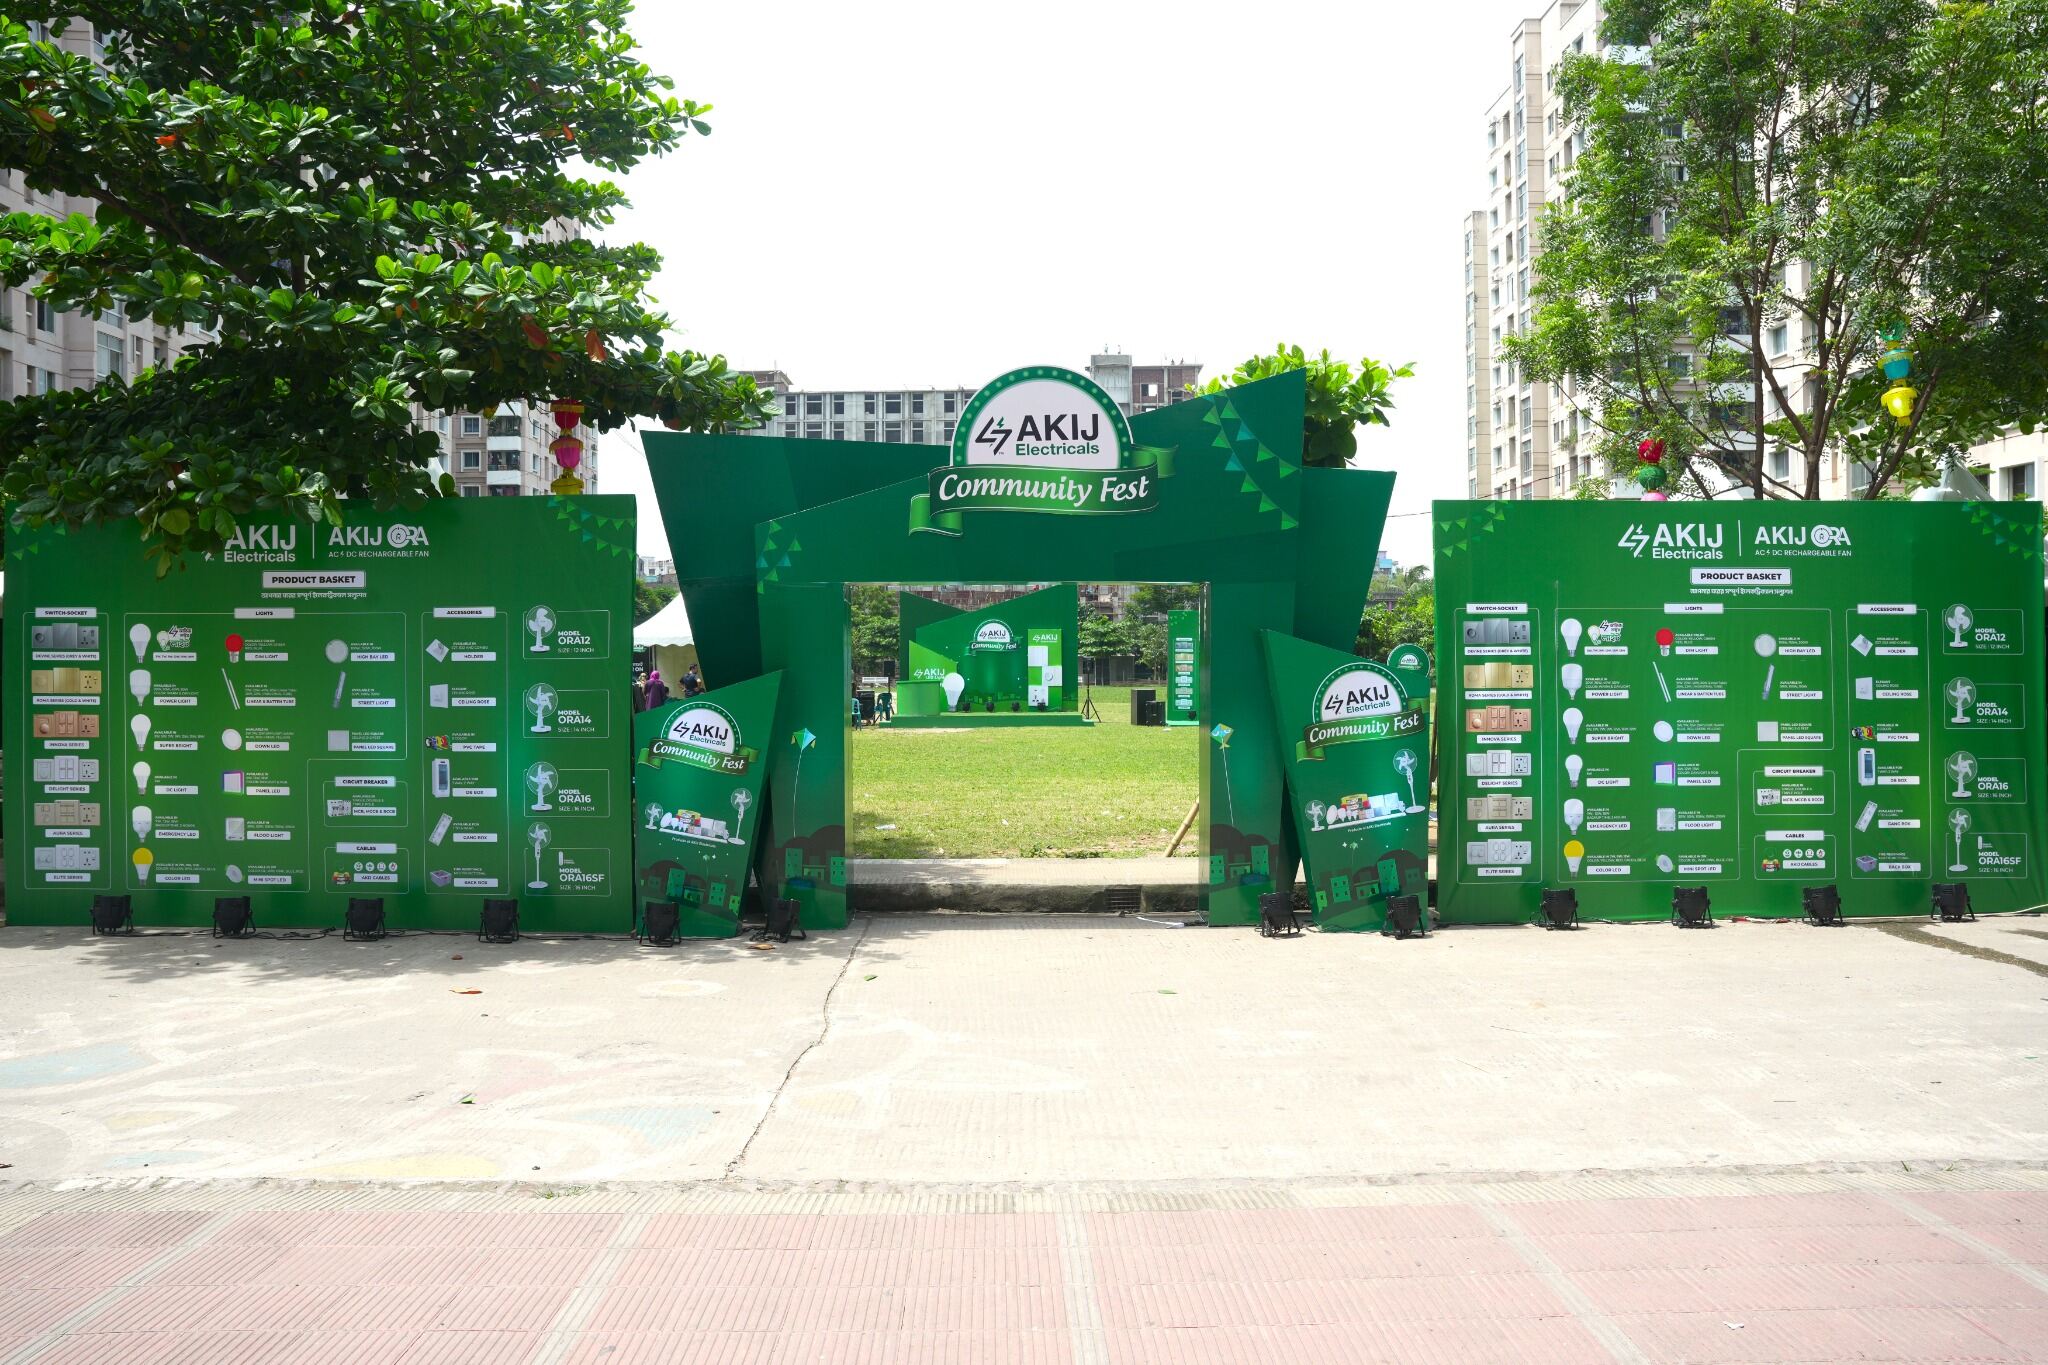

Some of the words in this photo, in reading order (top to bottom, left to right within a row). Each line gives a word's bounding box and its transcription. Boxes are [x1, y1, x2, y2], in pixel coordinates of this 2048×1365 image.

[1016, 413, 1099, 442] AKIJ
[1016, 443, 1099, 456] Electricals
[939, 474, 1092, 507] Community
[1100, 476, 1149, 502] Fest
[225, 525, 296, 549] AKIJ
[328, 526, 382, 546] AKIJ
[1652, 524, 1723, 548] AKIJ
[1755, 526, 1806, 545] AKIJ
[224, 551, 296, 562] Electricals
[1652, 548, 1723, 559] Electricals
[1346, 684, 1390, 705] AKIJ
[1346, 700, 1390, 714] Electricals
[691, 723, 728, 740] AKIJ
[1310, 720, 1390, 743] Community
[1394, 714, 1419, 731] Fest
[690, 734, 726, 747] Electricals
[653, 742, 720, 767] Community
[722, 757, 744, 770] Fest
